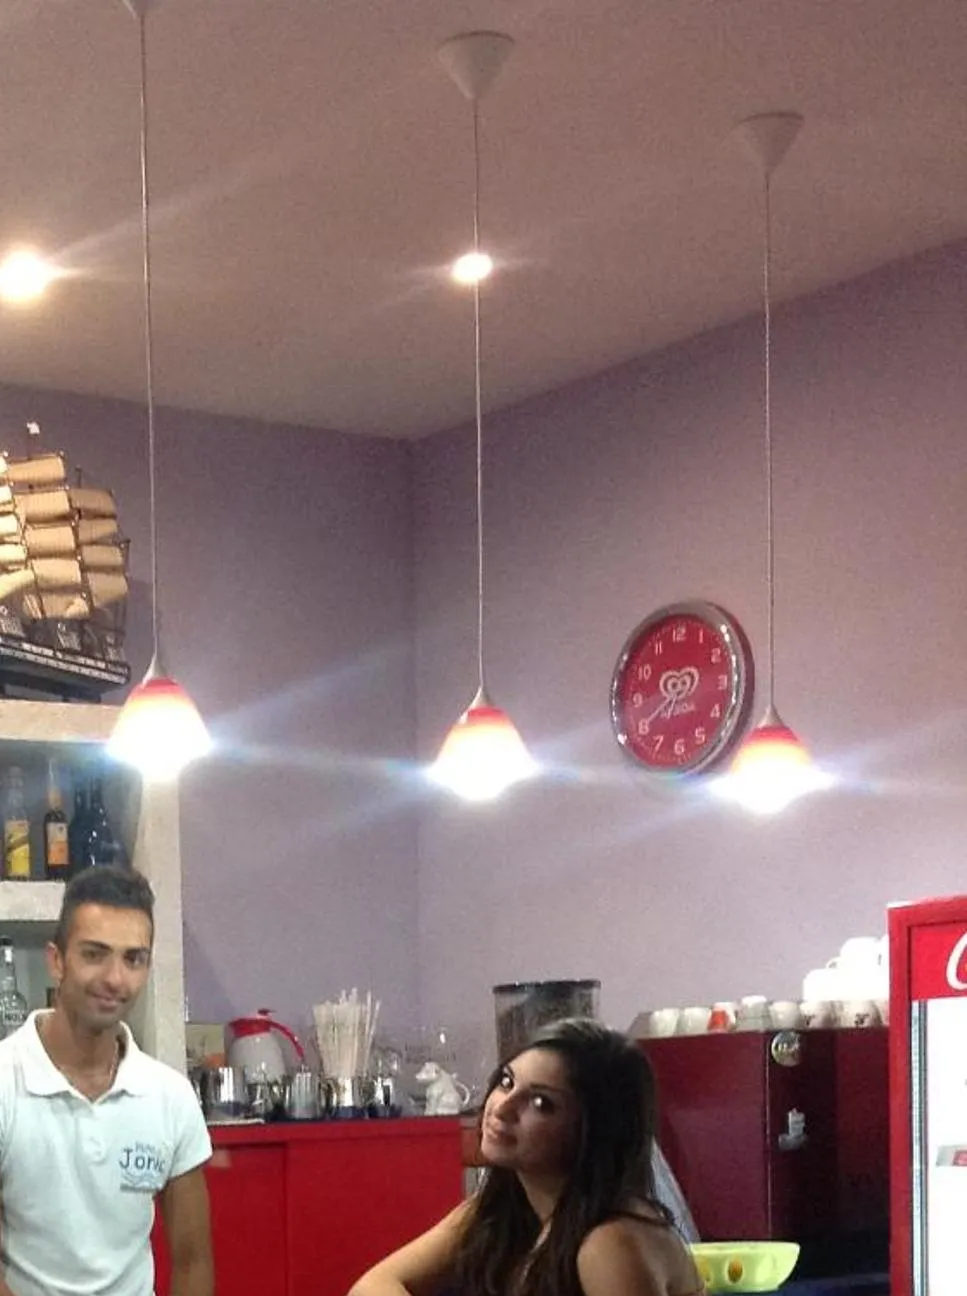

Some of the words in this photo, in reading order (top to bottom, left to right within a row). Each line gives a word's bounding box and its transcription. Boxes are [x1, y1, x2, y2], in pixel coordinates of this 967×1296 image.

[672, 627, 686, 642] 12
[698, 631, 704, 644] 1
[654, 640, 663, 655] 11
[711, 648, 722, 663] 2
[638, 664, 652, 681] 10
[718, 675, 728, 690] 3
[633, 692, 643, 708] 9
[710, 704, 721, 718] 4
[638, 720, 650, 735] 8
[653, 735, 664, 751] 7
[695, 727, 706, 745] 5
[675, 739, 685, 755] 6
